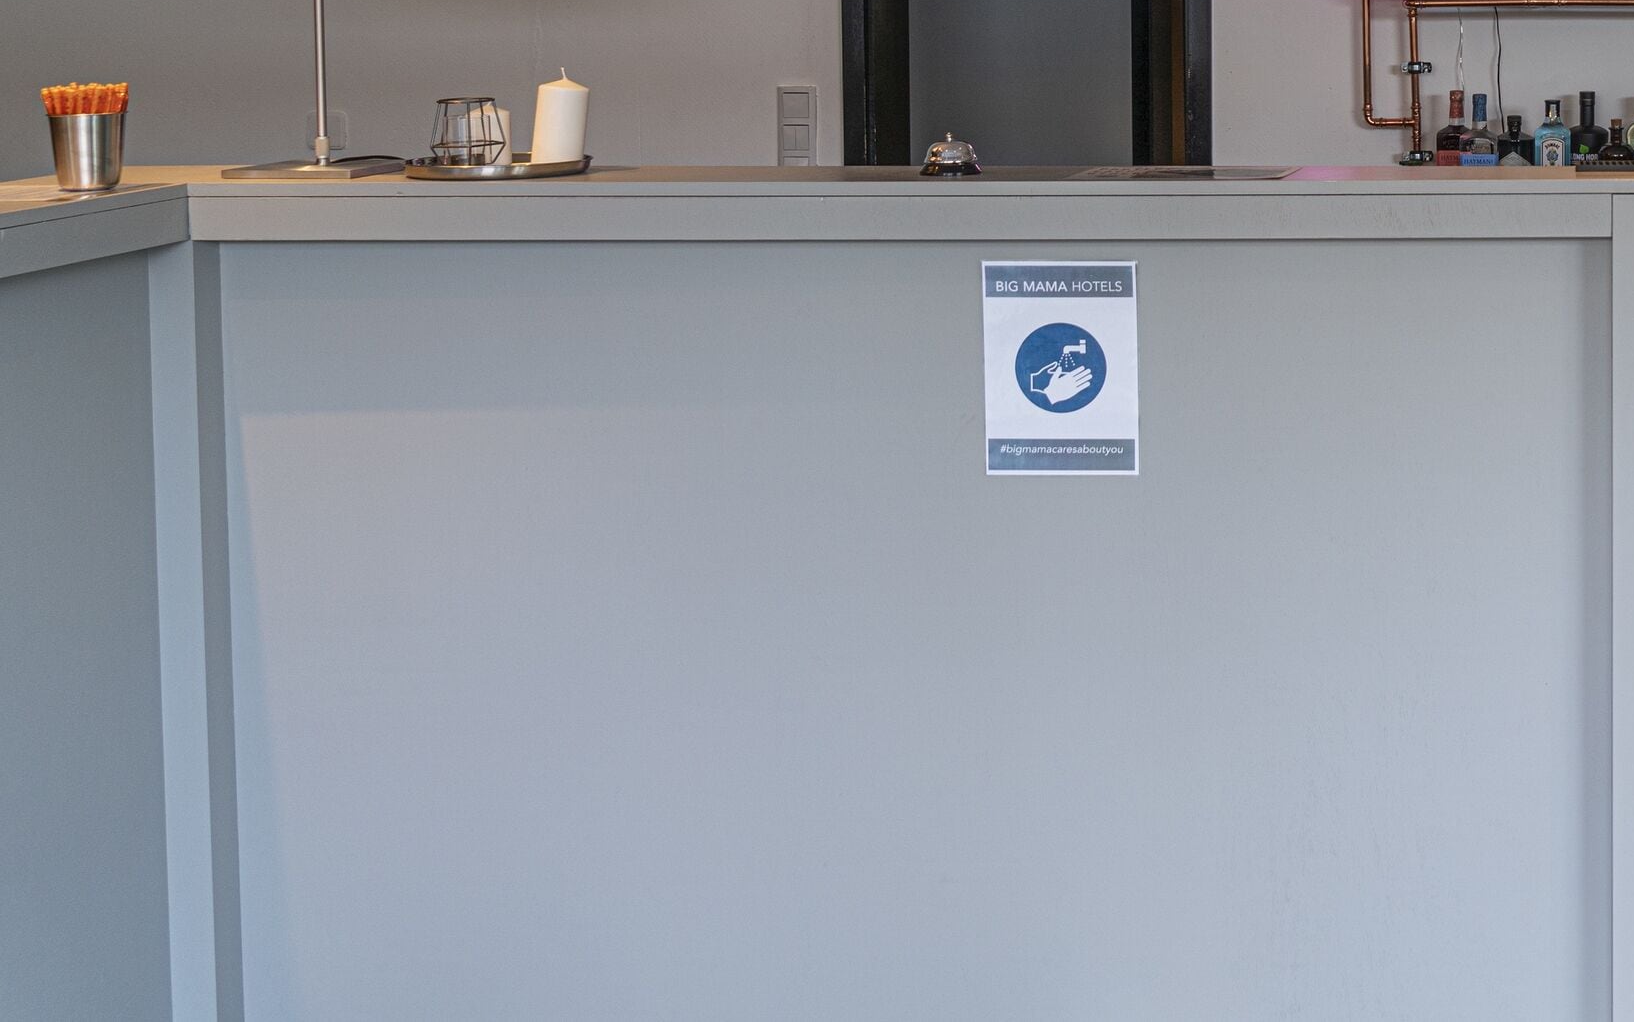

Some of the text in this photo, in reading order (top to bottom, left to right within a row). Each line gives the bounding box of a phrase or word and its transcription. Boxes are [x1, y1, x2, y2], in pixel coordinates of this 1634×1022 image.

[995, 281, 1122, 292] BIG MAMA HOTELS
[1000, 443, 1124, 456] #bigmamacaresaboutyou
